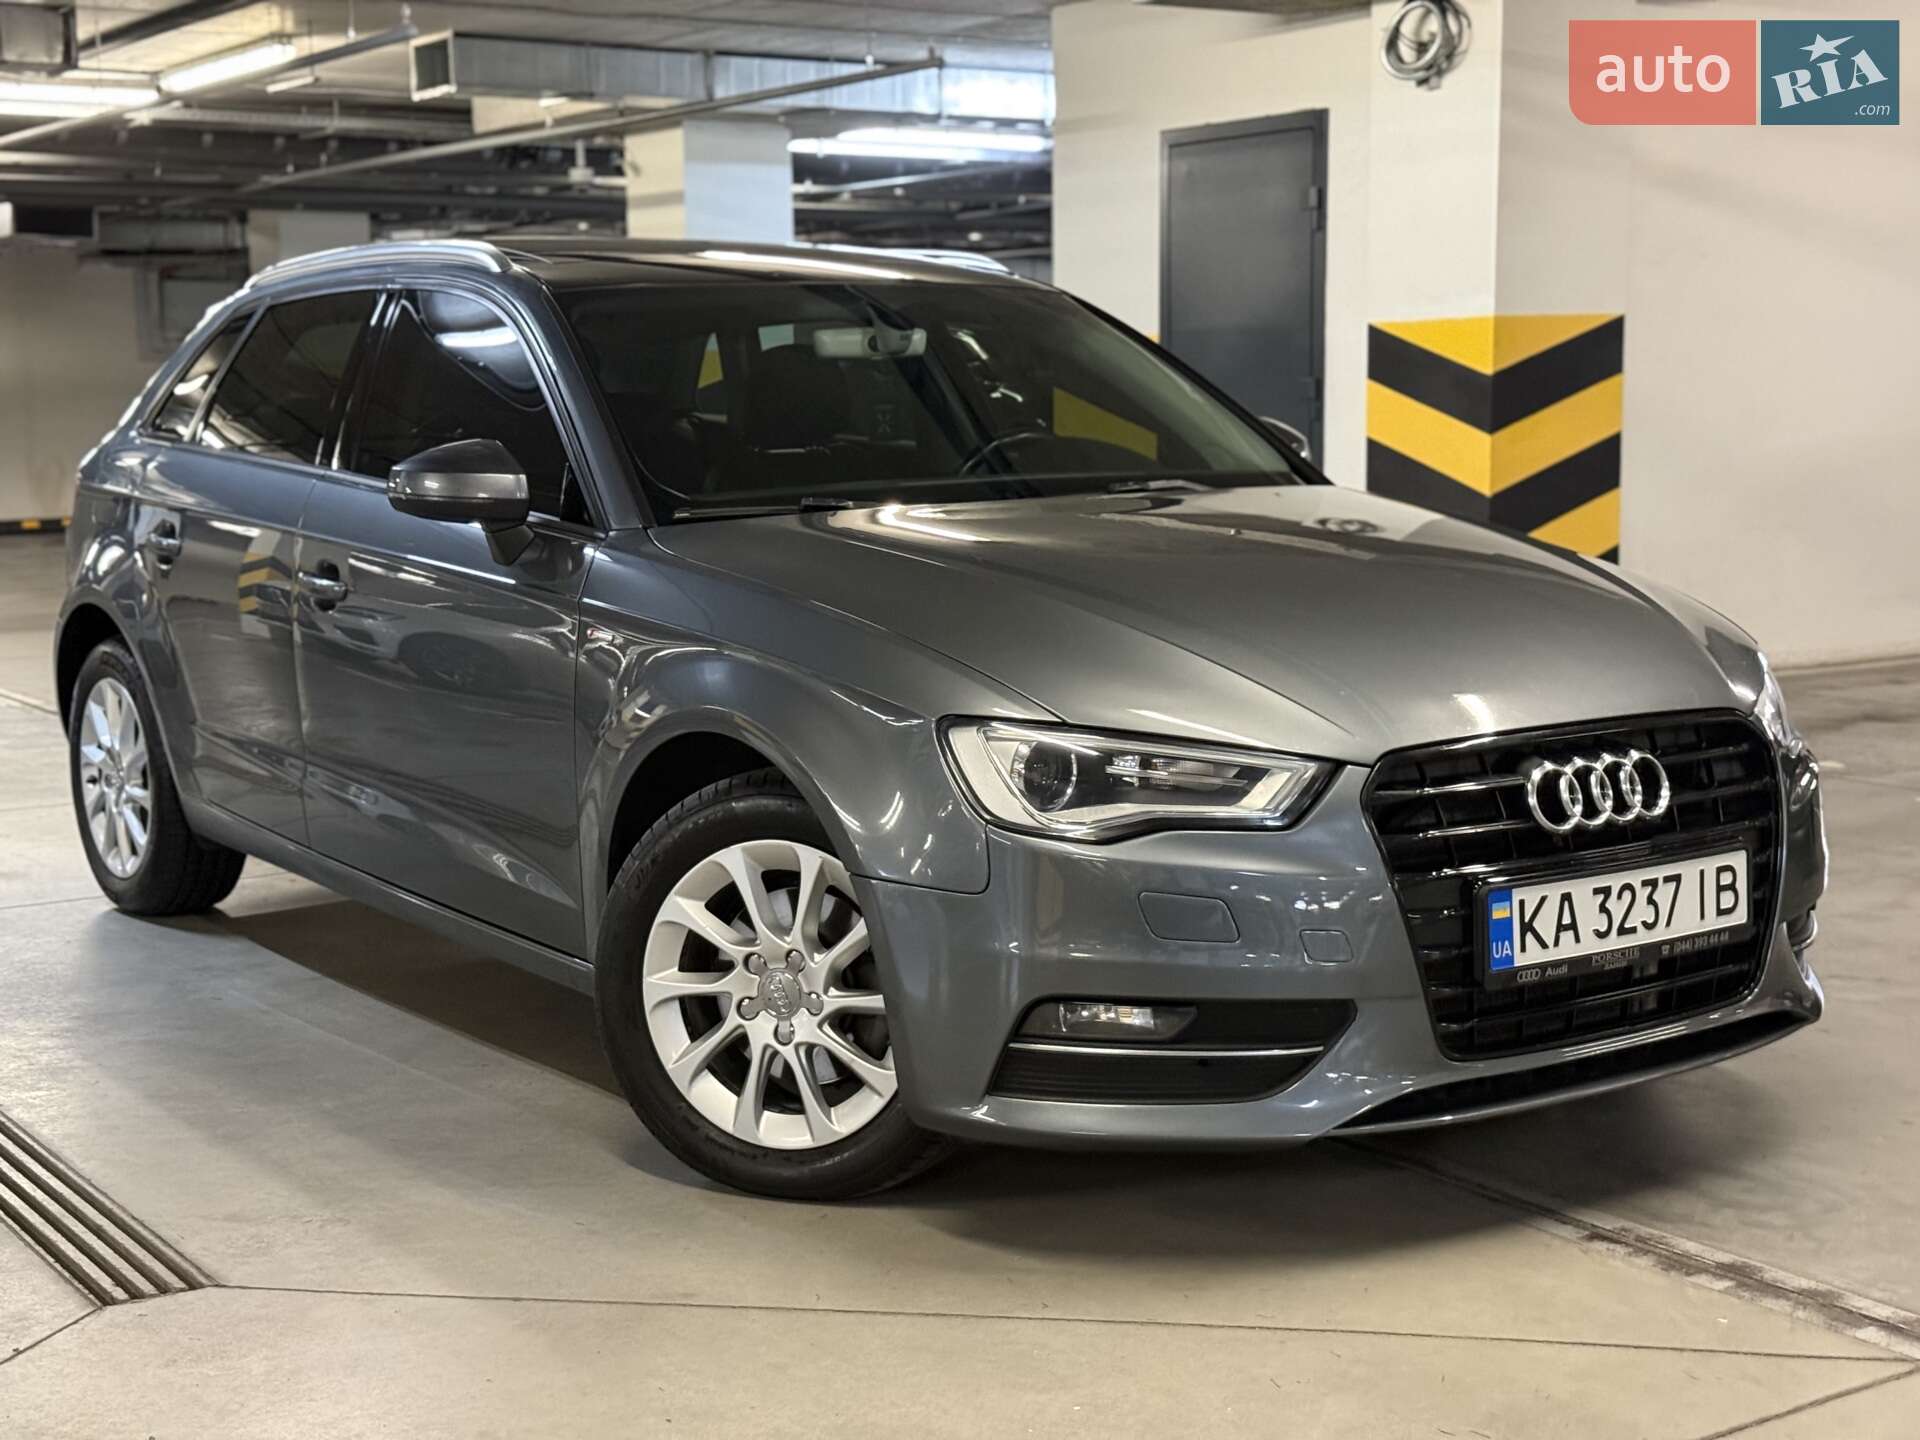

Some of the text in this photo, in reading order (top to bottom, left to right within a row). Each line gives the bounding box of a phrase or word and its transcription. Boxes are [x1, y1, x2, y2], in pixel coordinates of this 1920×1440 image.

[1518, 864, 1740, 953] KA 3237 IB
[1492, 940, 1512, 958] UA
[1545, 964, 1568, 977] Audi
